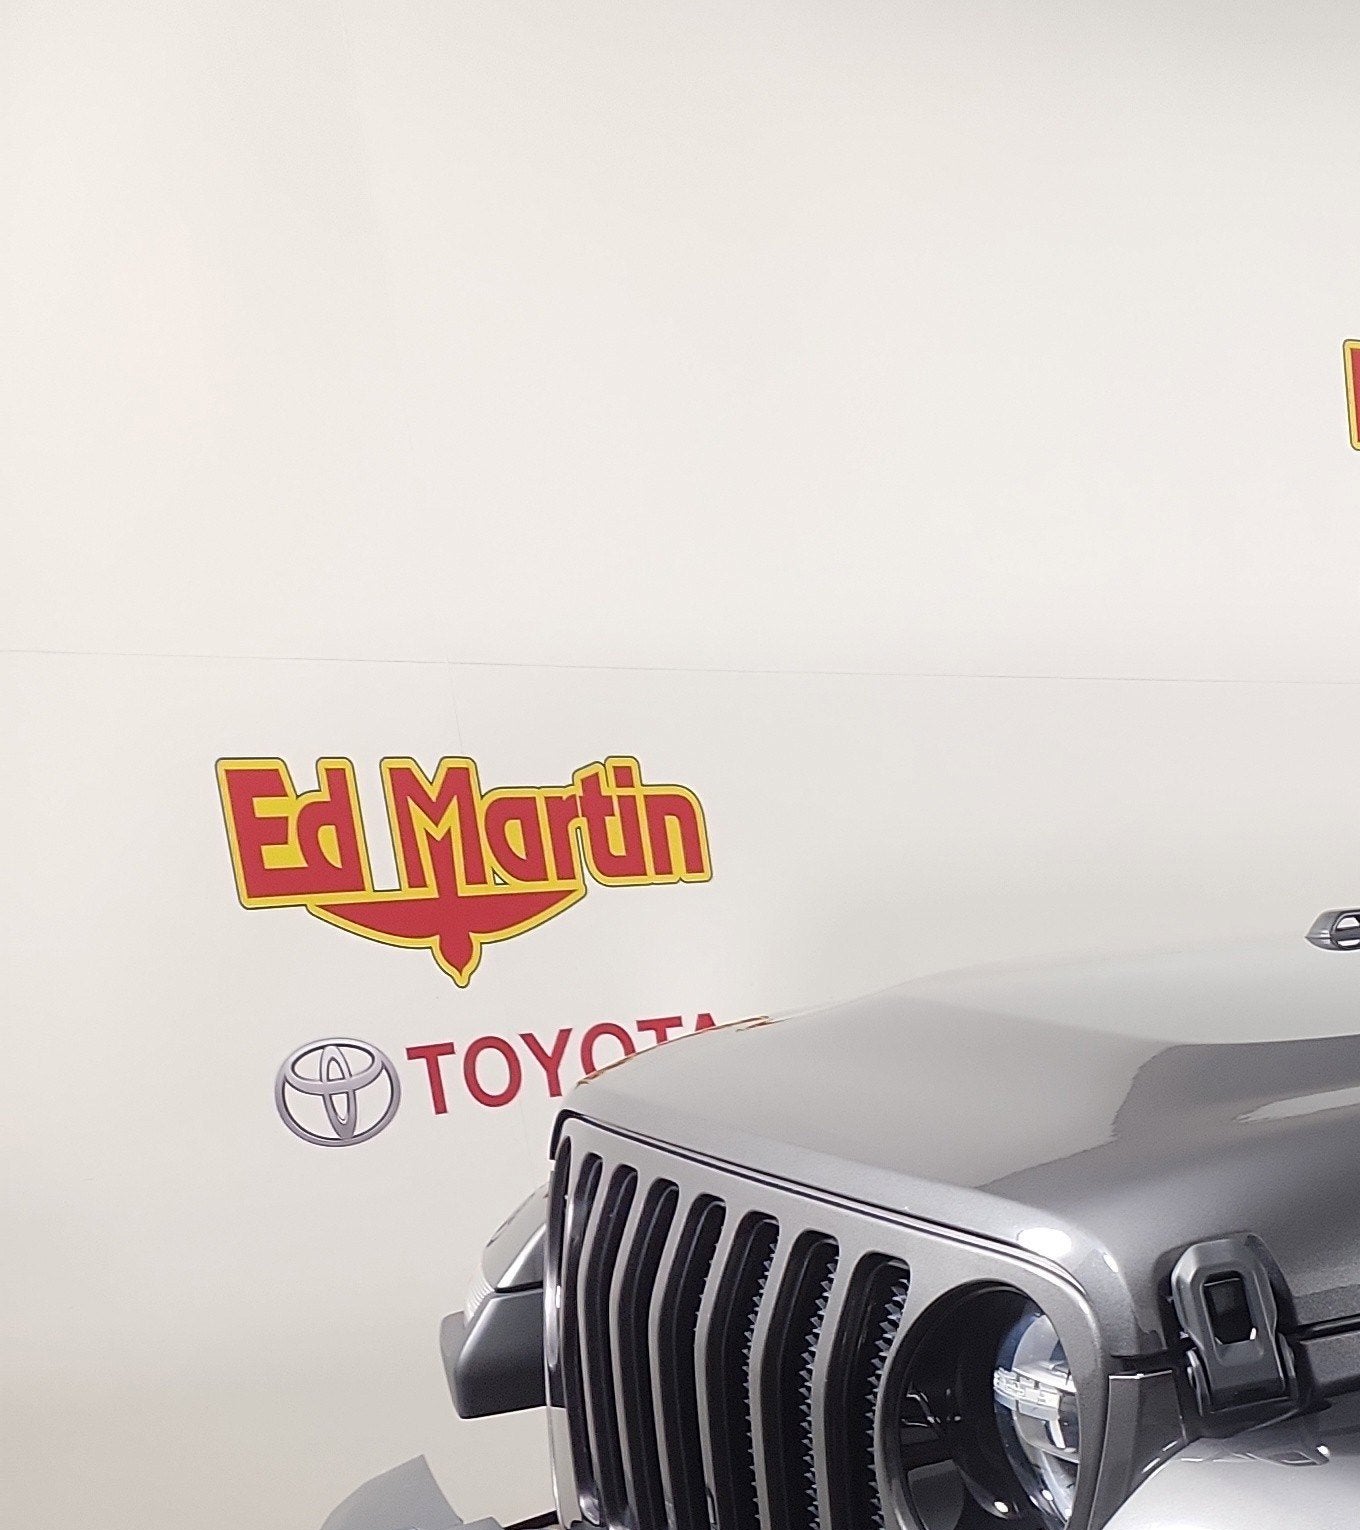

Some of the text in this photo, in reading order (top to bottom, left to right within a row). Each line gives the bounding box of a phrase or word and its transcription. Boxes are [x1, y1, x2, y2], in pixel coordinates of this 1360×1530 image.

[220, 761, 706, 902] Ed Martin
[406, 1013, 716, 1114] TOYOT
